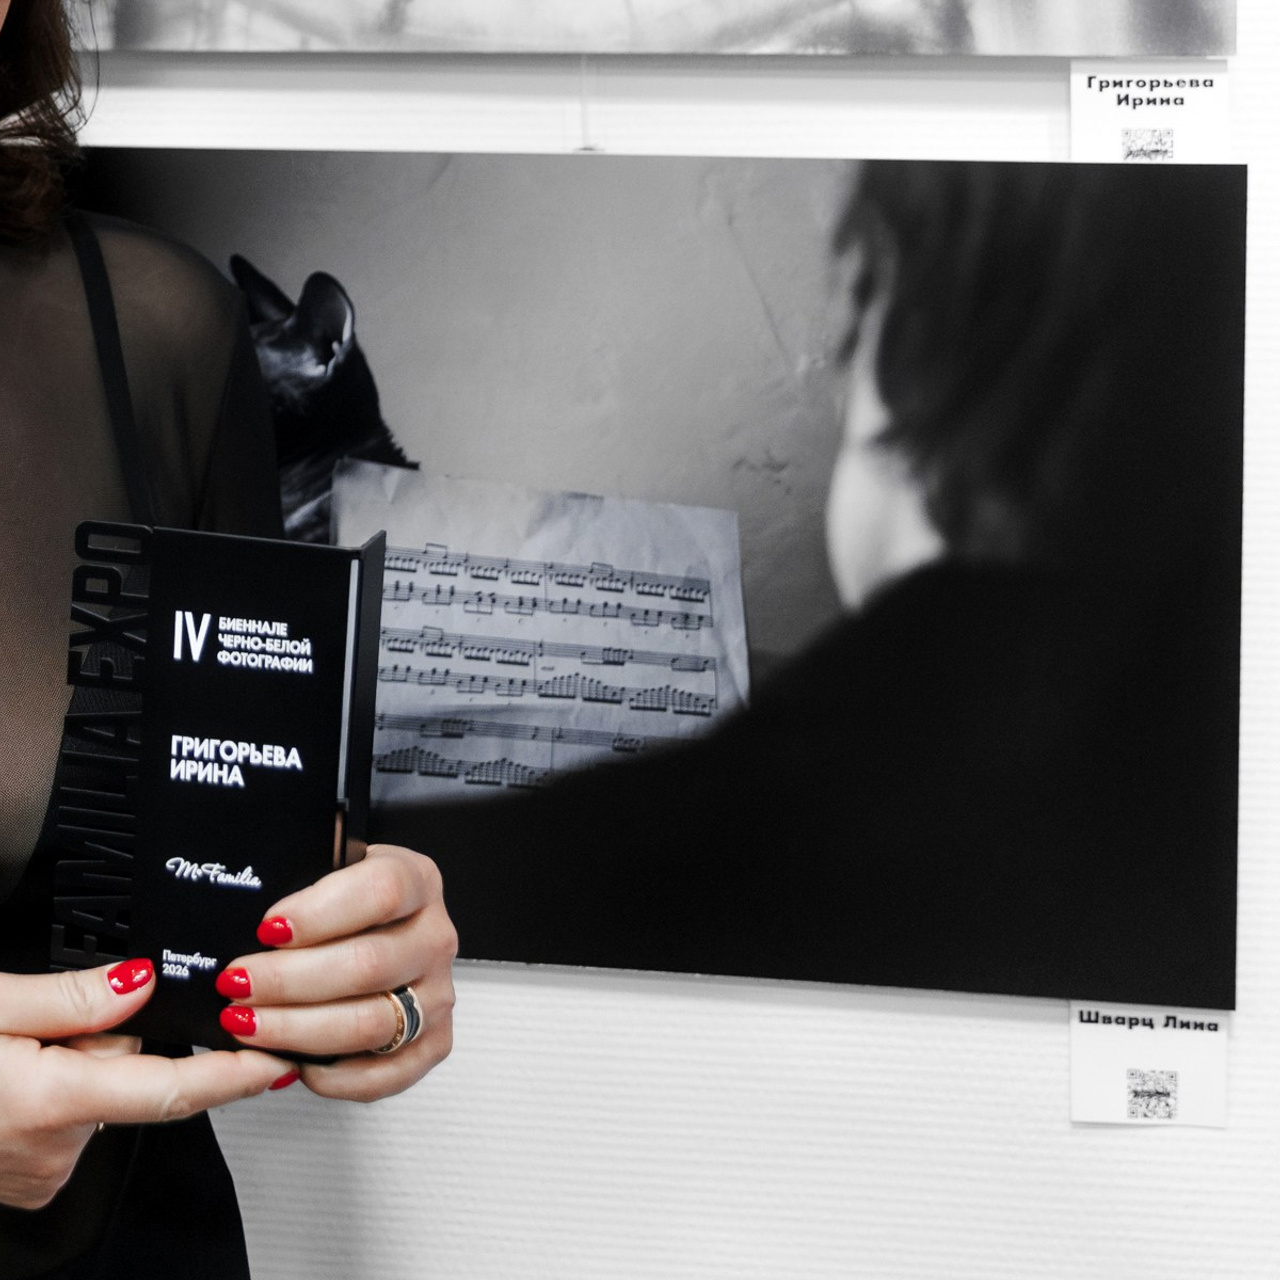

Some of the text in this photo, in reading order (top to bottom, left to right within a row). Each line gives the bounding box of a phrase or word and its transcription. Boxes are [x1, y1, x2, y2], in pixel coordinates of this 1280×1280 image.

[1087, 75, 1214, 92] Григорьева
[1117, 94, 1185, 109] Ирина
[66, 520, 153, 686] EXPO
[173, 610, 212, 662] IV
[218, 616, 288, 636] БИЕННАЛЕ
[217, 633, 312, 656] ЧЕРНО-БЕЛОЙ
[217, 650, 314, 673] ФОТОГРАФИИ
[171, 734, 303, 770] ГРИГОРЬЕВА
[170, 759, 246, 787] ИРИНА
[162, 949, 218, 970] Петербург
[162, 963, 189, 977] 2026
[1079, 1010, 1219, 1032] Шварц Лина
